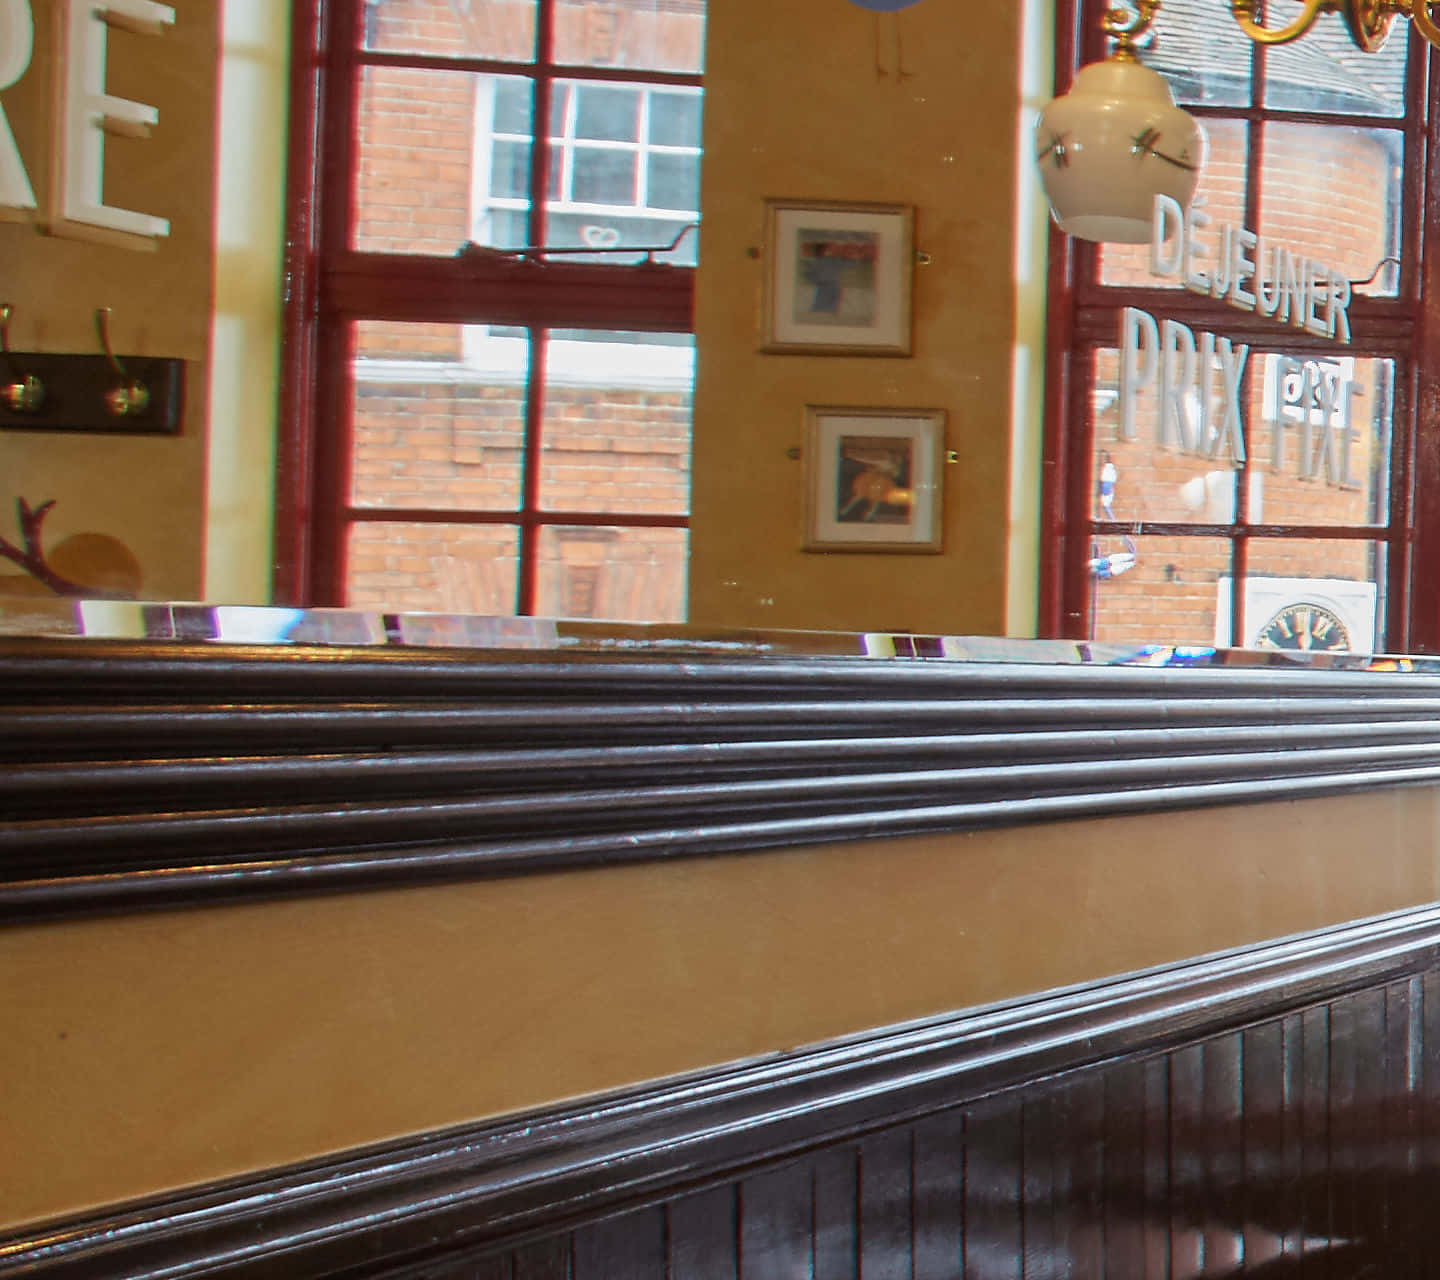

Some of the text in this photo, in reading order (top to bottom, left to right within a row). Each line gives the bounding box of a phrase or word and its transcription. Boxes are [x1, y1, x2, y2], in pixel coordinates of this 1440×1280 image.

[1151, 192, 1352, 345] DÉJEUNER
[1119, 306, 1366, 492] PRIX FIXE
